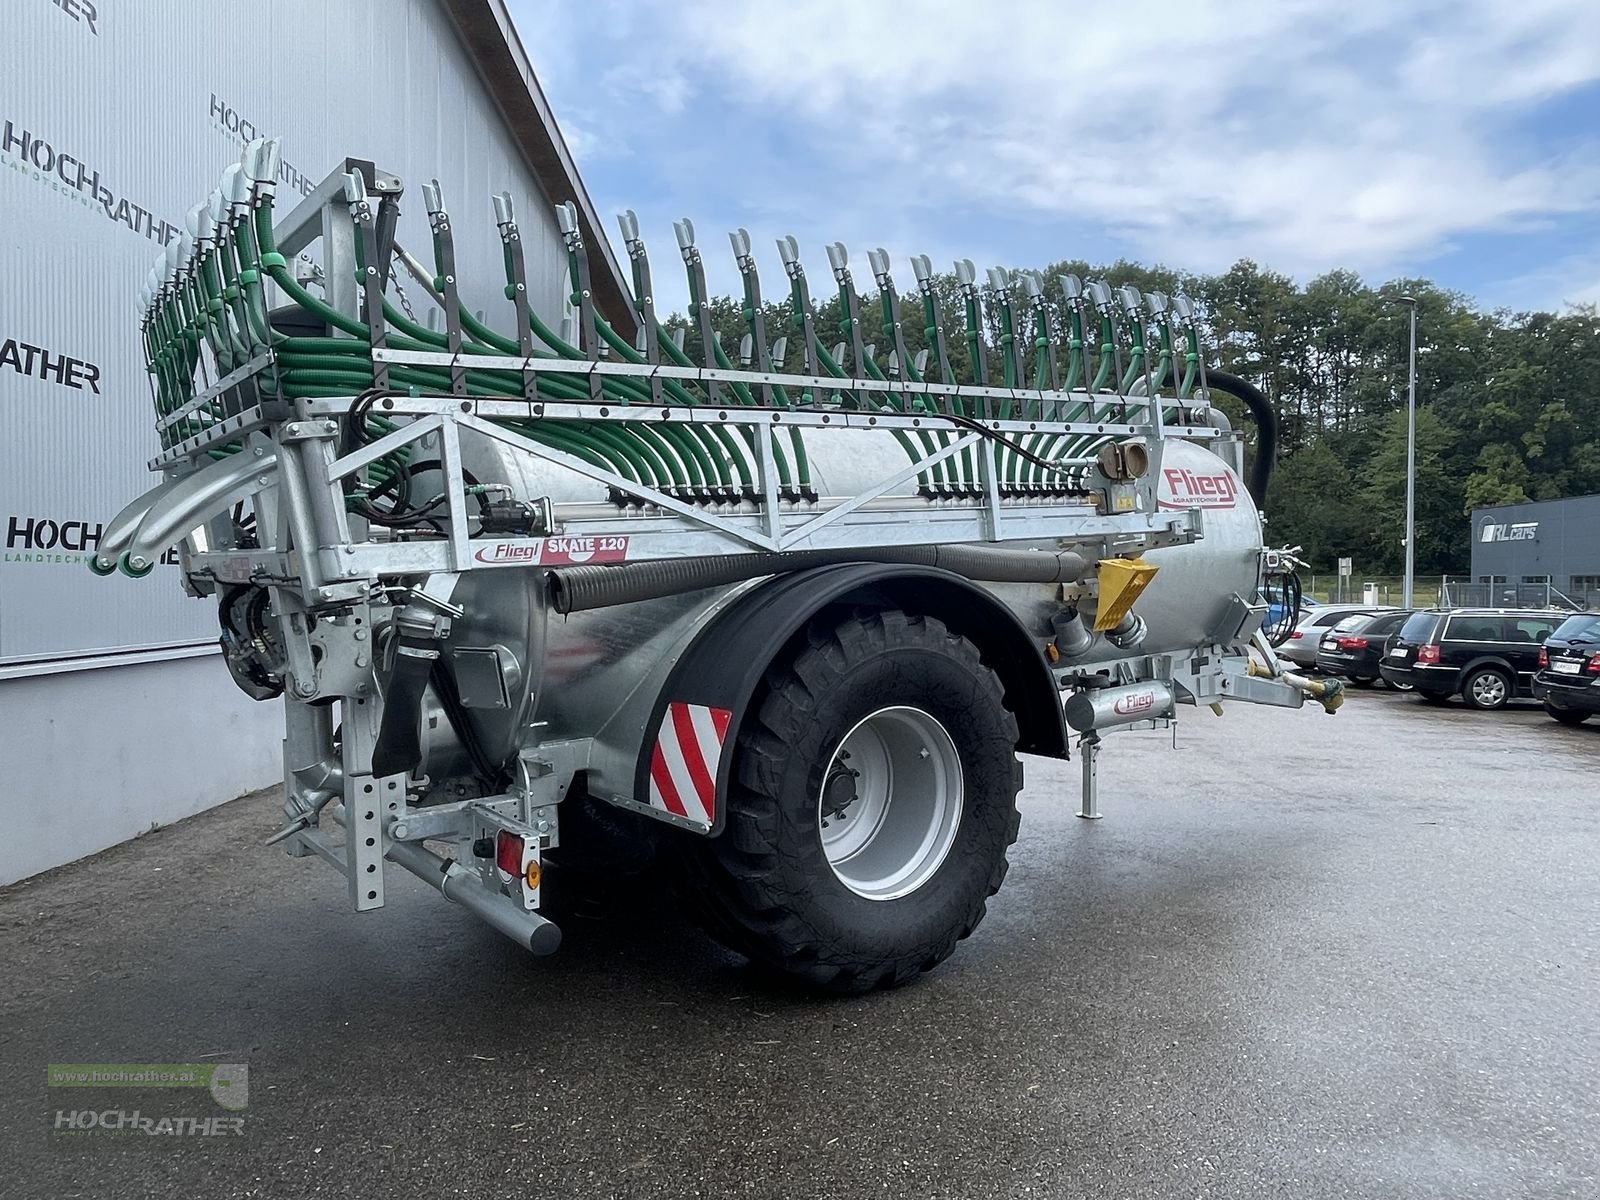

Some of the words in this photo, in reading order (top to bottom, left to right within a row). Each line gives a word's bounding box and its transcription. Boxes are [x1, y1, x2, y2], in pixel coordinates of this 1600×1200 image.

[2, 120, 183, 247] HOCHRATHE
[0, 338, 101, 395] ATHER
[1164, 469, 1237, 502] Fliegl
[495, 543, 538, 558] Fliegl
[548, 538, 594, 552] SKATE
[600, 538, 625, 550] 120
[1126, 691, 1154, 708] Fliegl
